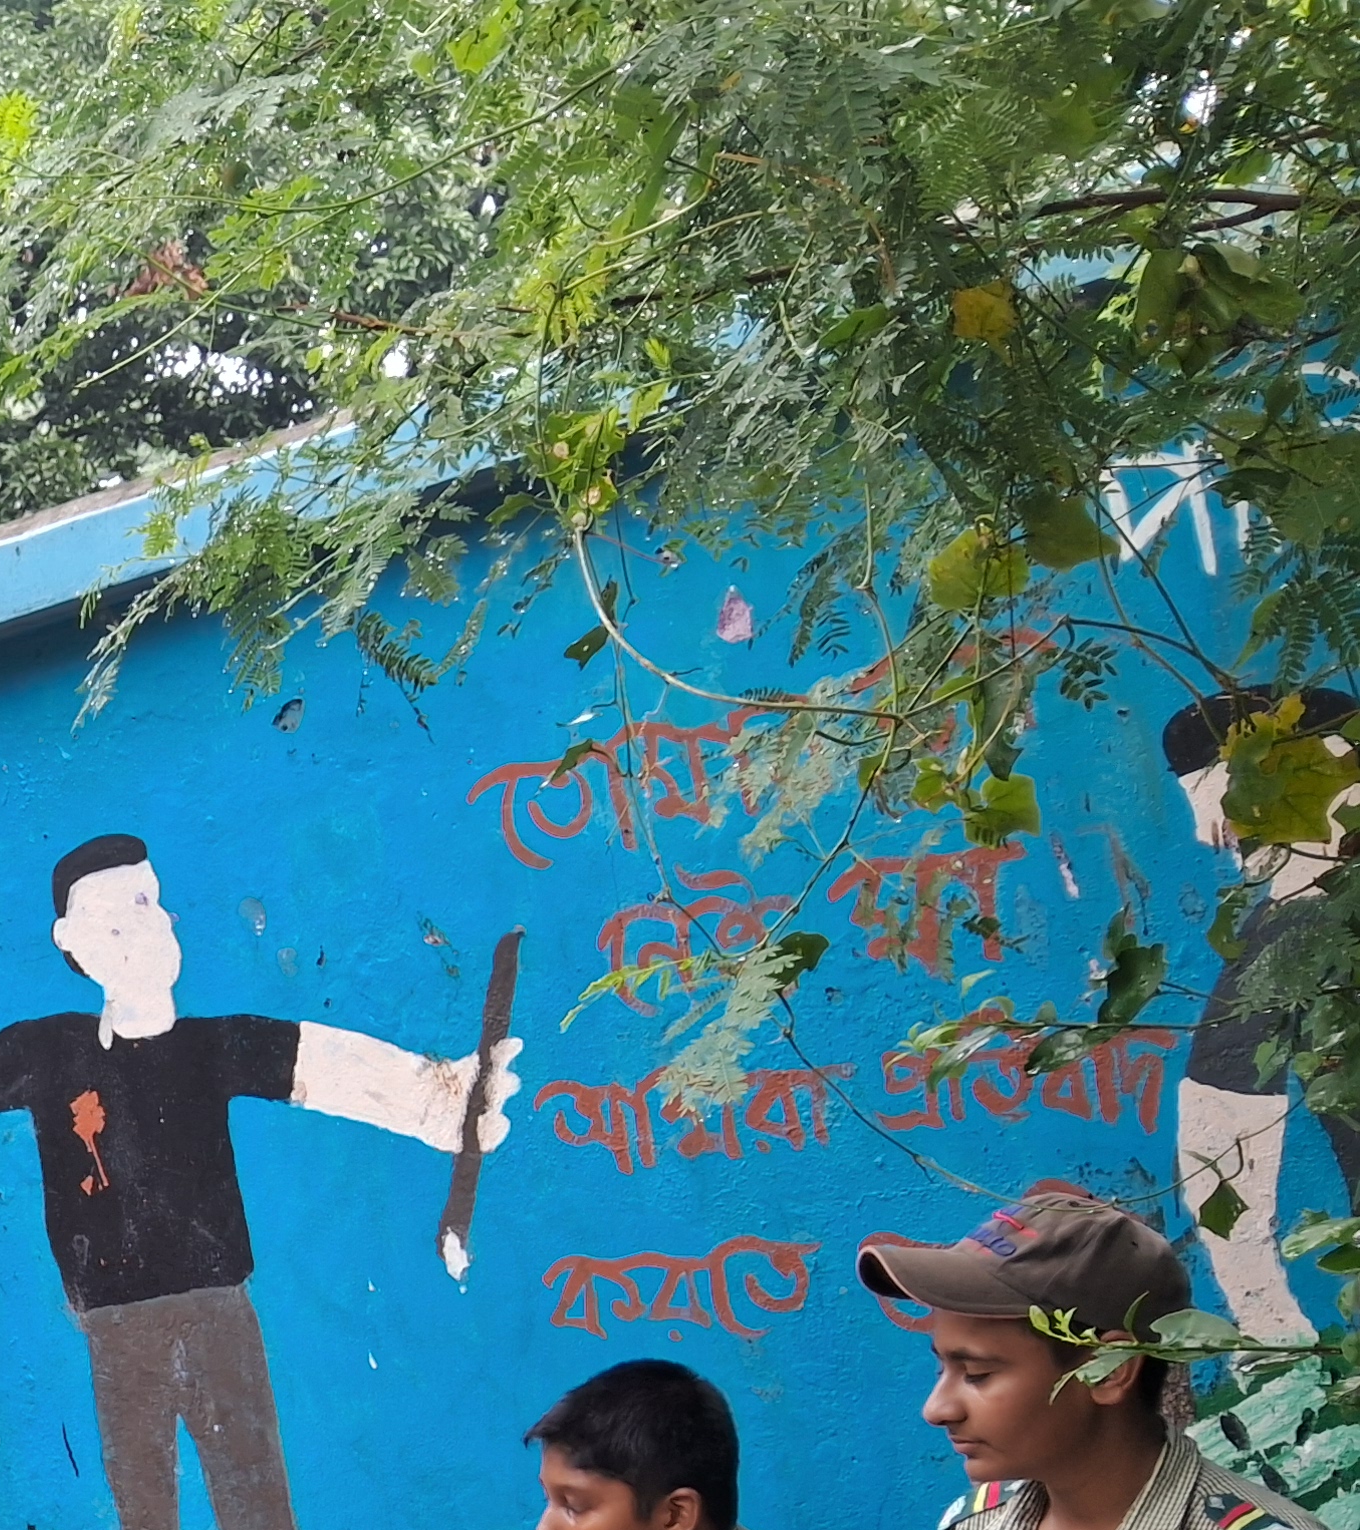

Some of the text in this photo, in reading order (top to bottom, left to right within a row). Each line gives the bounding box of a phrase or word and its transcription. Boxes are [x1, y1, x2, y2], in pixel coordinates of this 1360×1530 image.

[468, 694, 808, 869] তোমা
[535, 1061, 857, 1175] আমরা
[542, 1235, 823, 1340] করতে
